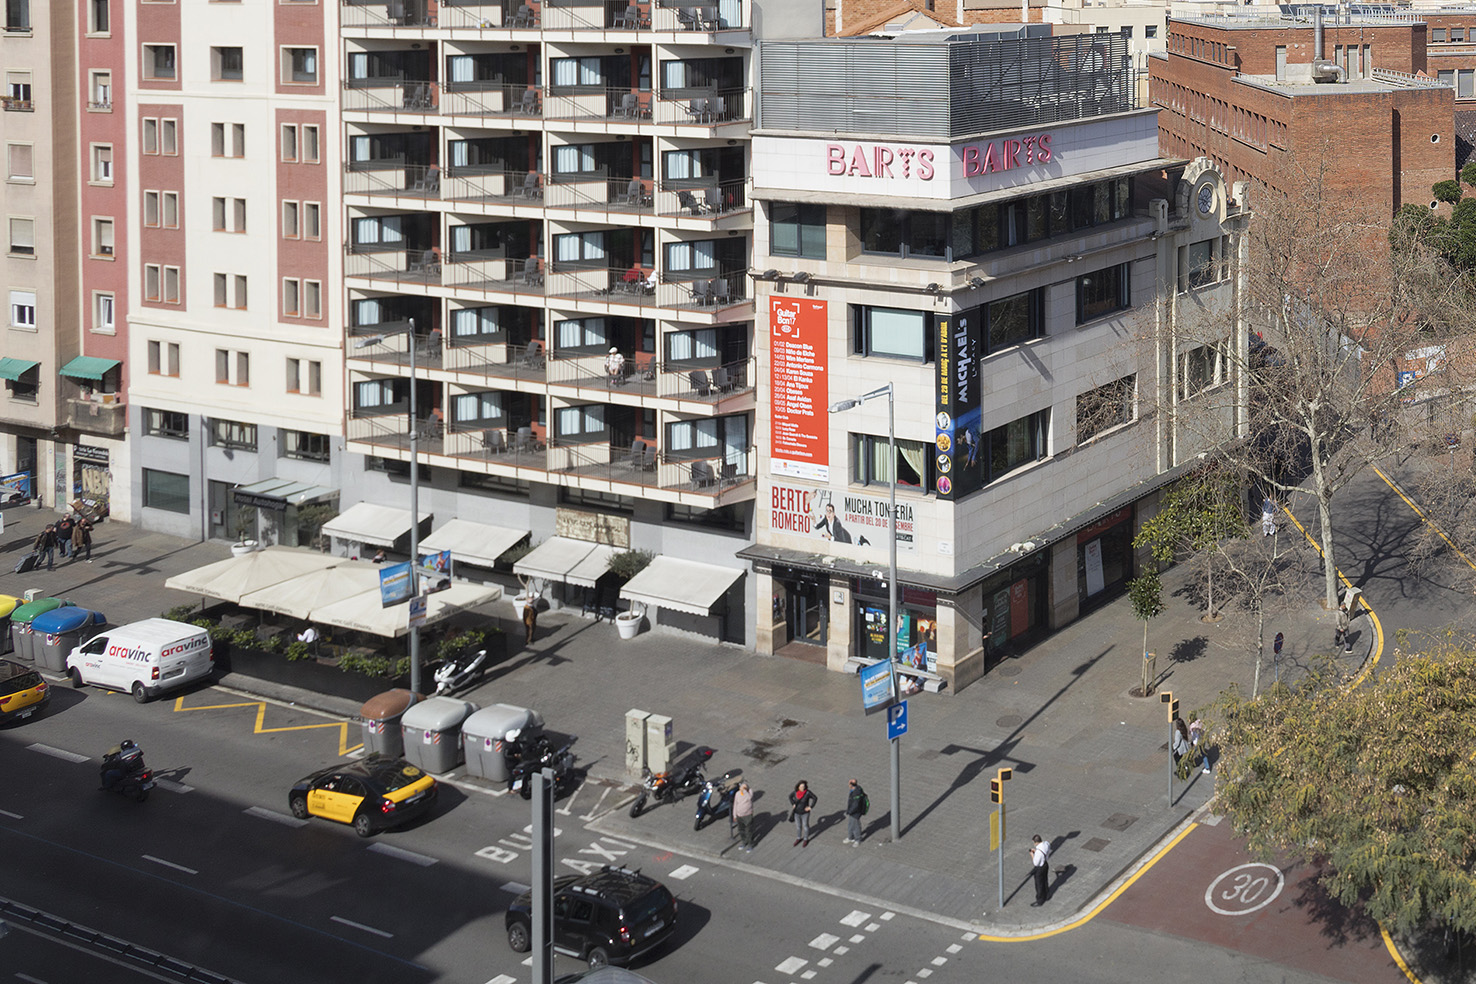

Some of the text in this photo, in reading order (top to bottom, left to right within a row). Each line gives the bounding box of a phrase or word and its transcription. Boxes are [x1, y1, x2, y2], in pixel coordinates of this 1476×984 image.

[827, 143, 935, 181] BARTS
[962, 134, 1052, 178] BARTS
[777, 308, 796, 318] Guitar
[772, 486, 810, 514] BERTO
[845, 497, 913, 521] MUCHA TONERÍA
[772, 510, 810, 533] ROMERO
[845, 513, 848, 521] A
[849, 513, 865, 524] PARTIR
[109, 645, 152, 663] aravinc
[161, 636, 208, 657] aravinc
[891, 705, 904, 725] P
[560, 836, 637, 875] AXI
[1222, 873, 1270, 904] 30
